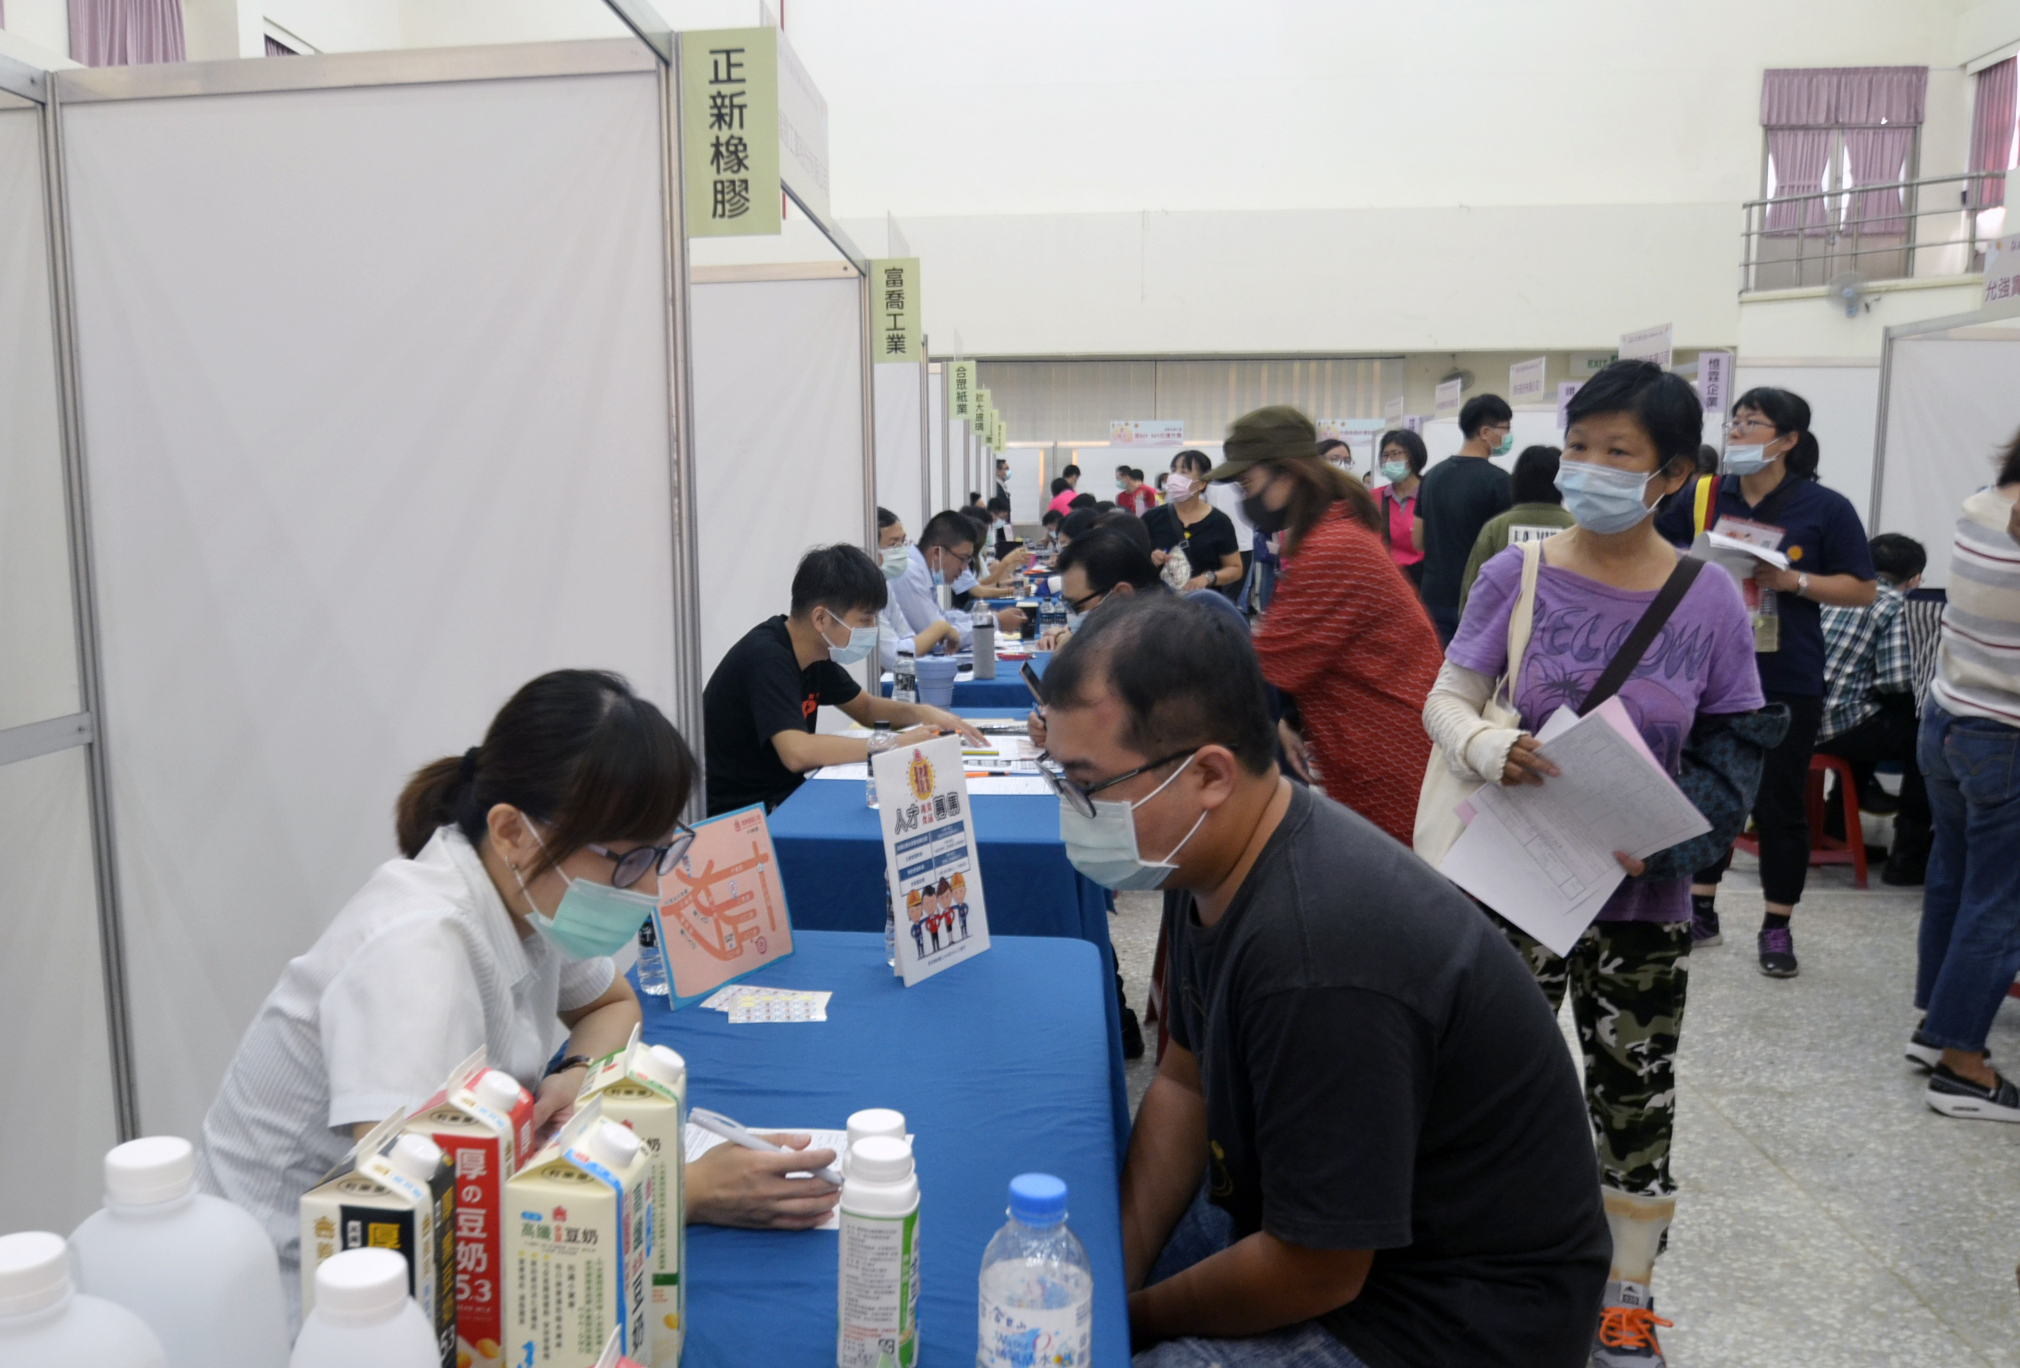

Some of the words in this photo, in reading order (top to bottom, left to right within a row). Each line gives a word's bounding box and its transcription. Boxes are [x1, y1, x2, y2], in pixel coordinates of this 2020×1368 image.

[708, 47, 750, 220] 正新橡膠
[884, 266, 907, 355] 富喬工業
[1587, 358, 1608, 369] EXIT
[1706, 357, 1721, 408] 憶霖企業
[894, 803, 920, 836] 人才
